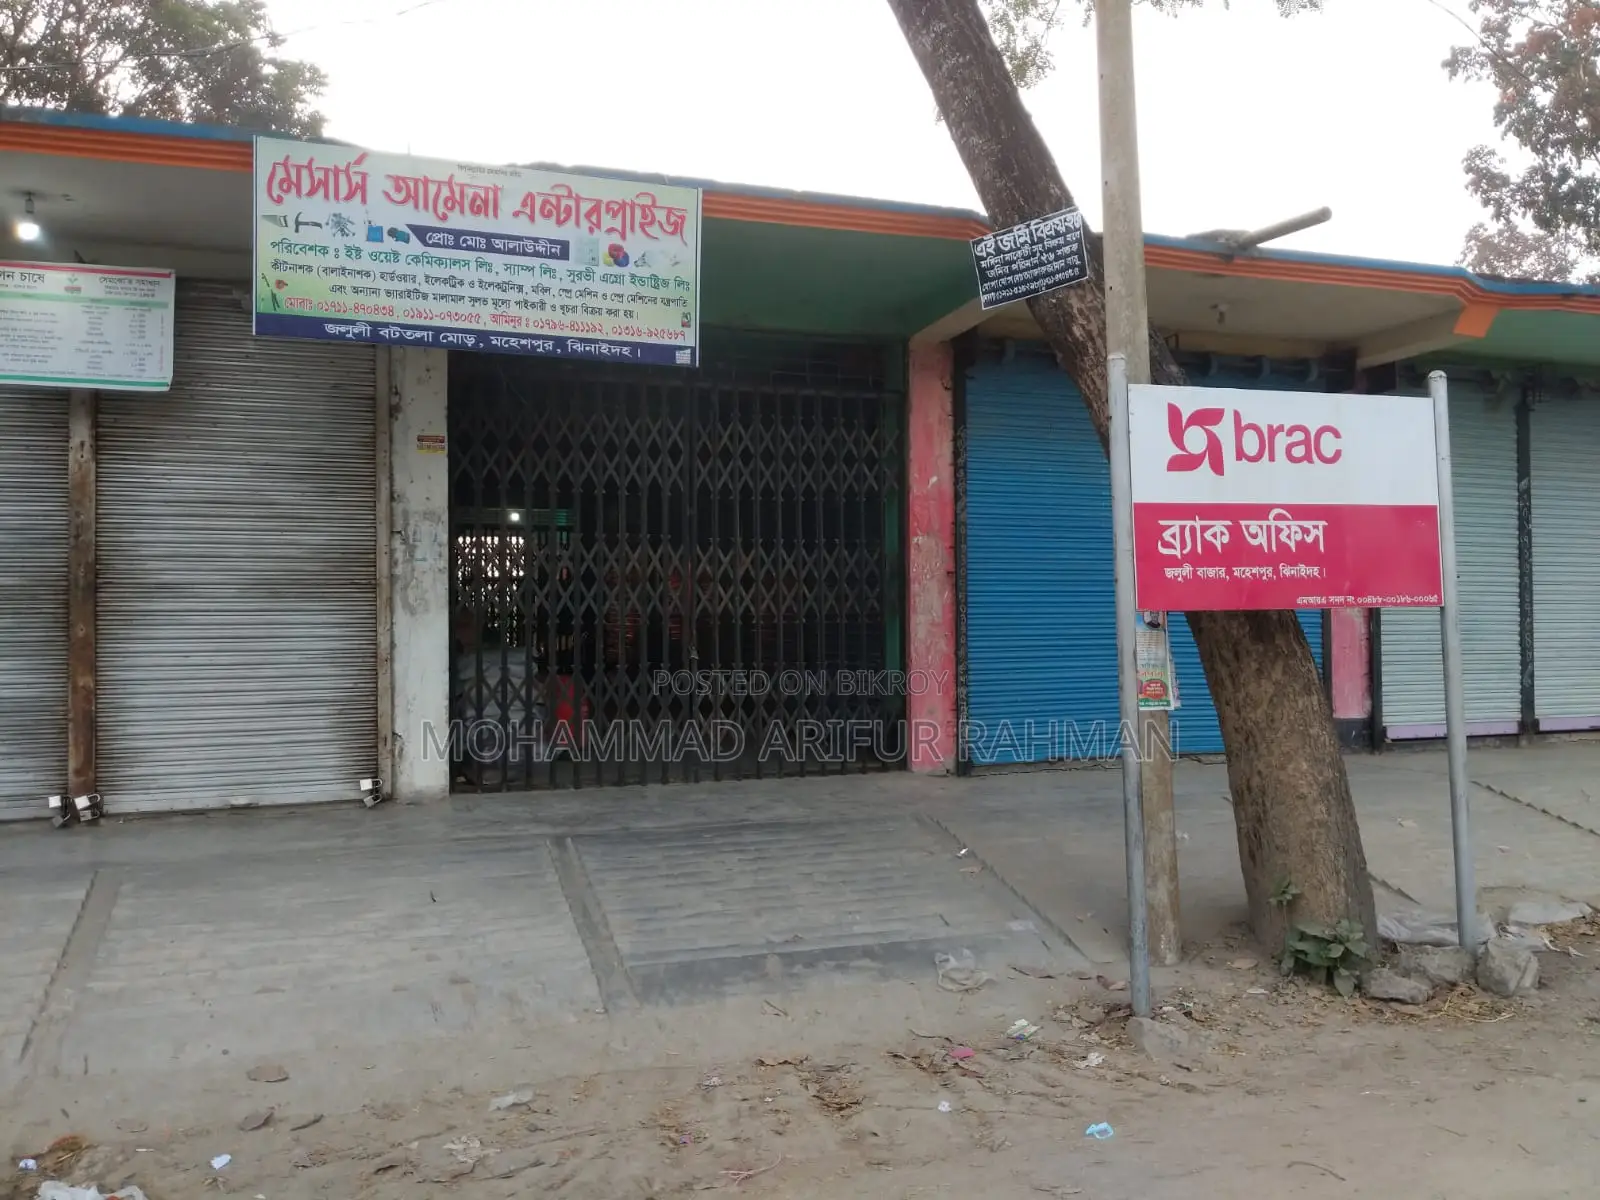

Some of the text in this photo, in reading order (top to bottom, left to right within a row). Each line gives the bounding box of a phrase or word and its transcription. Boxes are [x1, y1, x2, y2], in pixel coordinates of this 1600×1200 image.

[266, 152, 689, 248] মেসার্স আমেনা এন্টারপ্রাইজ
[425, 231, 561, 257] প্রোঃ মোঃ আলাউদ্দীন
[974, 234, 997, 257] এই
[996, 223, 1032, 251] জমি
[270, 238, 330, 258] পরিবেশক
[405, 251, 471, 271] কেমিক্যালস
[674, 275, 690, 292] লিঃ
[270, 259, 314, 274] কীটনাশক
[316, 264, 376, 282] (বালাইনাশক)
[468, 280, 475, 289] ও
[574, 287, 598, 300] মেশিন
[602, 293, 608, 301] ও
[328, 284, 347, 295] এবং
[350, 285, 381, 297] অন্যান্য
[432, 293, 465, 304] মালামাল
[468, 296, 489, 308] সুলভ
[514, 298, 547, 312] পাইকারী
[550, 304, 556, 312] ও
[376, 325, 435, 342] বটতলা
[489, 311, 522, 329] আমিনুর
[1233, 409, 1342, 465] brac
[1157, 507, 1329, 559] ব্র্যাক অফিস
